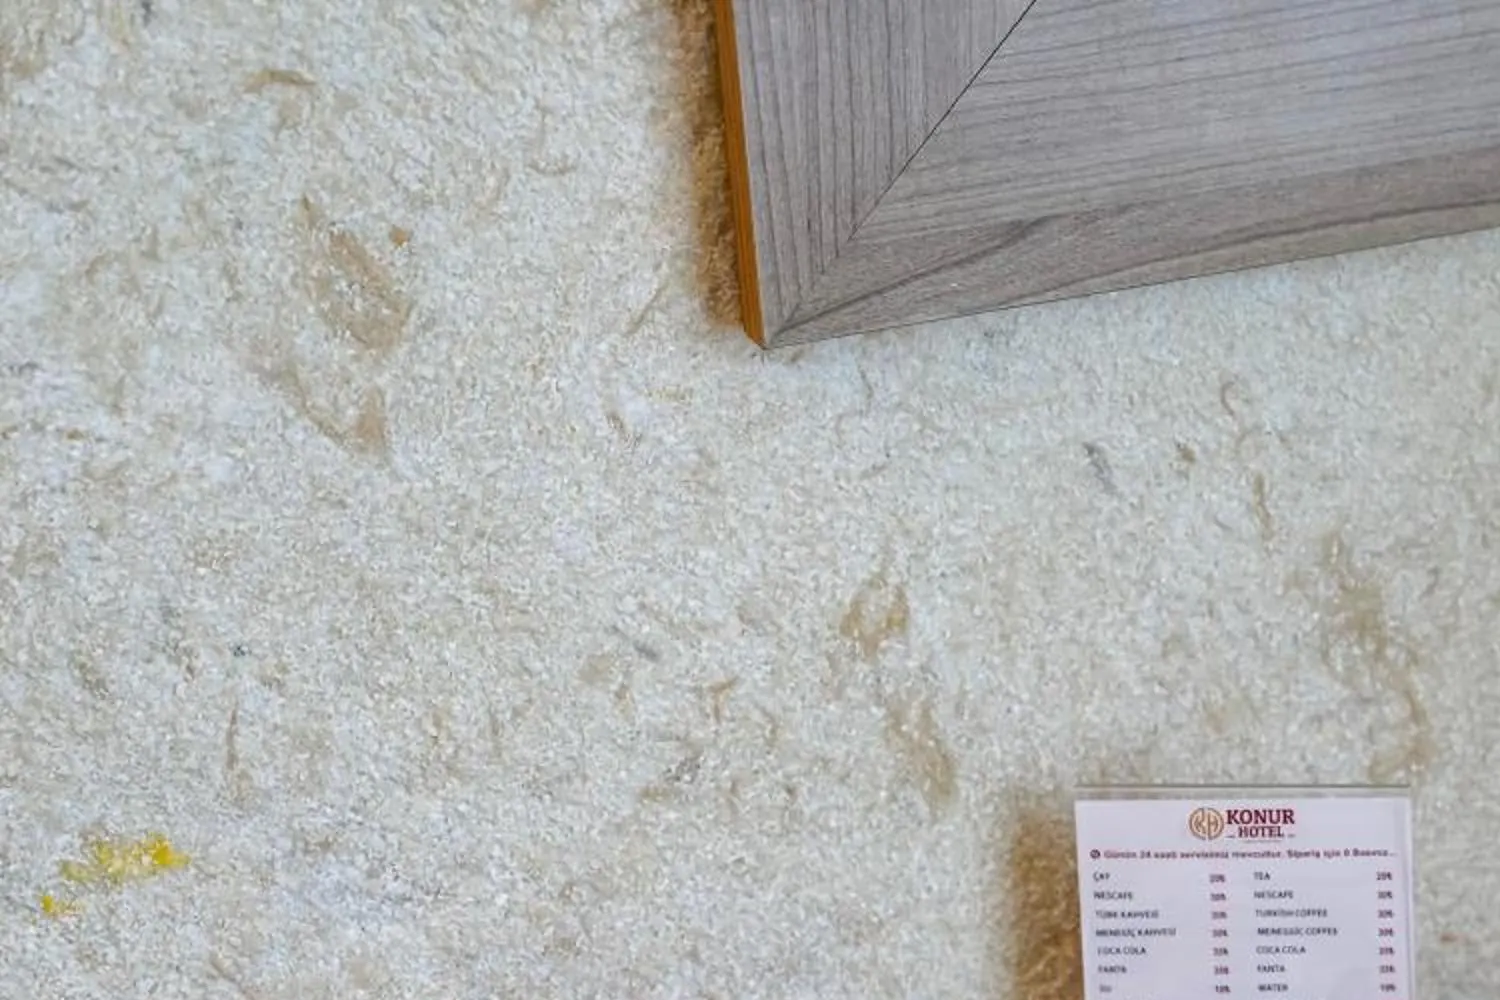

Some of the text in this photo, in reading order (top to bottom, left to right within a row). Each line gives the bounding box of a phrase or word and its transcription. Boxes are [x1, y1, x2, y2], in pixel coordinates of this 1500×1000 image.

[1226, 809, 1295, 824] KONUR
[1237, 826, 1284, 838] HOTEL
[1254, 872, 1270, 880] TEA
[1122, 946, 1146, 955] COLA
[1256, 945, 1306, 954] COCA COLA
[1257, 964, 1285, 973] FANTA
[1258, 983, 1288, 992] WATER
